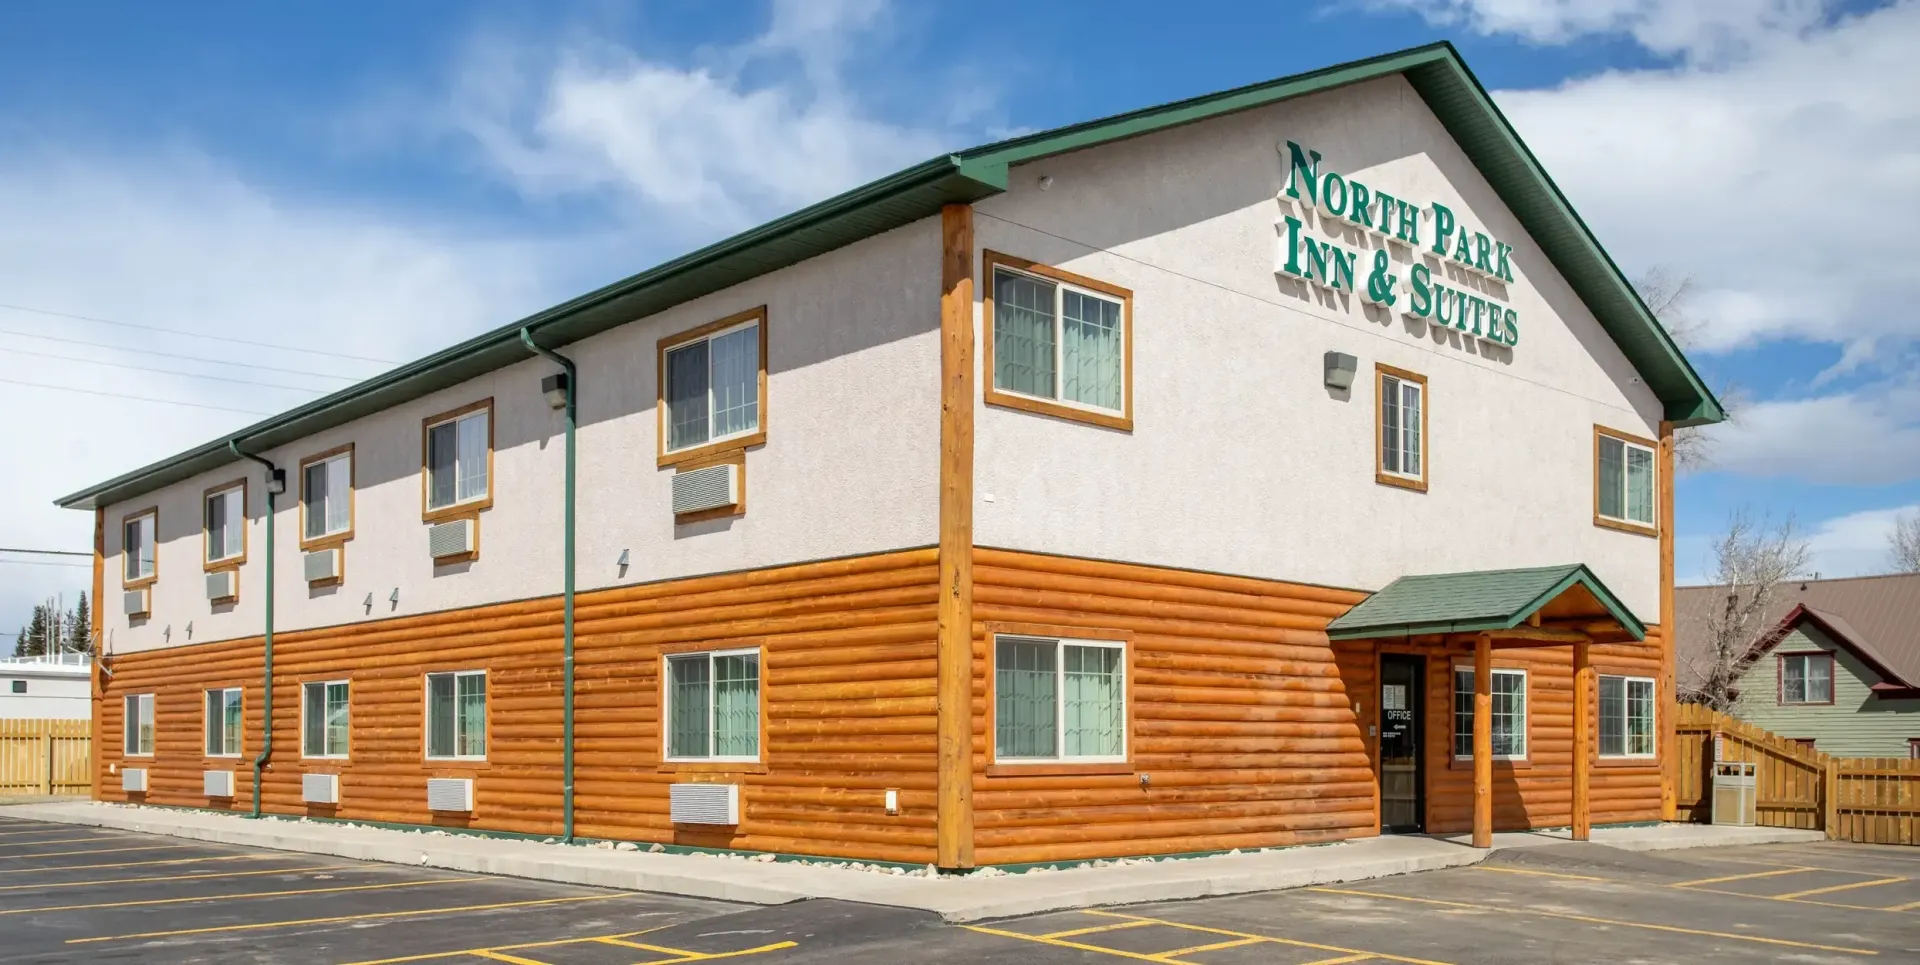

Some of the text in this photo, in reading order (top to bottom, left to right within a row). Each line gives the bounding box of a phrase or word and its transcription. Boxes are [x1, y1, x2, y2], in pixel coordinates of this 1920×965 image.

[1286, 140, 1514, 284] NORTH PARK
[1284, 215, 1518, 347] INN & SUITES
[1387, 710, 1411, 720] OFFICE
